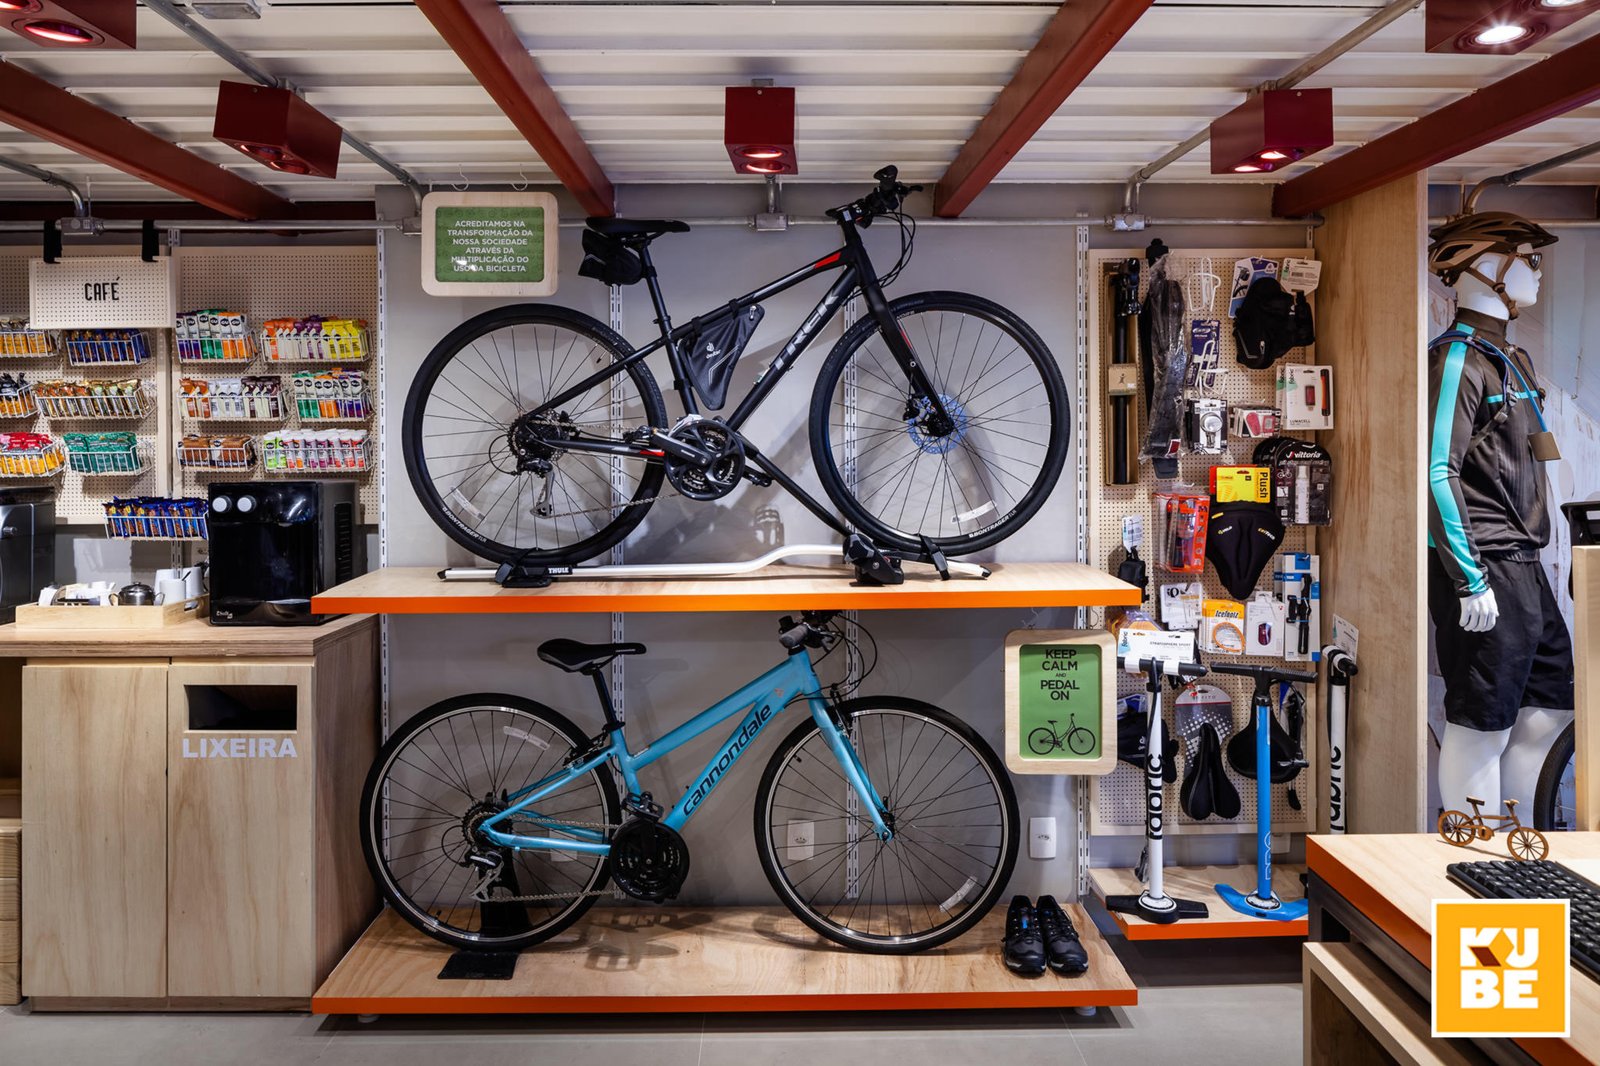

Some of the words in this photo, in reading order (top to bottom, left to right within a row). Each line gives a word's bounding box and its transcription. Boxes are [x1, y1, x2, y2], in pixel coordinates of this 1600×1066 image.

[447, 228, 519, 237] TRANSFORMAÇÃO
[465, 246, 501, 254] ATRAVÉS
[84, 276, 120, 301] CAFÉ
[774, 289, 839, 370] TREK
[1260, 472, 1268, 498] Plush
[1045, 649, 1077, 659] KEEP
[1042, 661, 1078, 671] CALM
[1040, 680, 1080, 690] PEDAL
[1050, 690, 1070, 700] ON
[182, 737, 298, 758] LIXEIRA
[683, 704, 772, 816] cannondale
